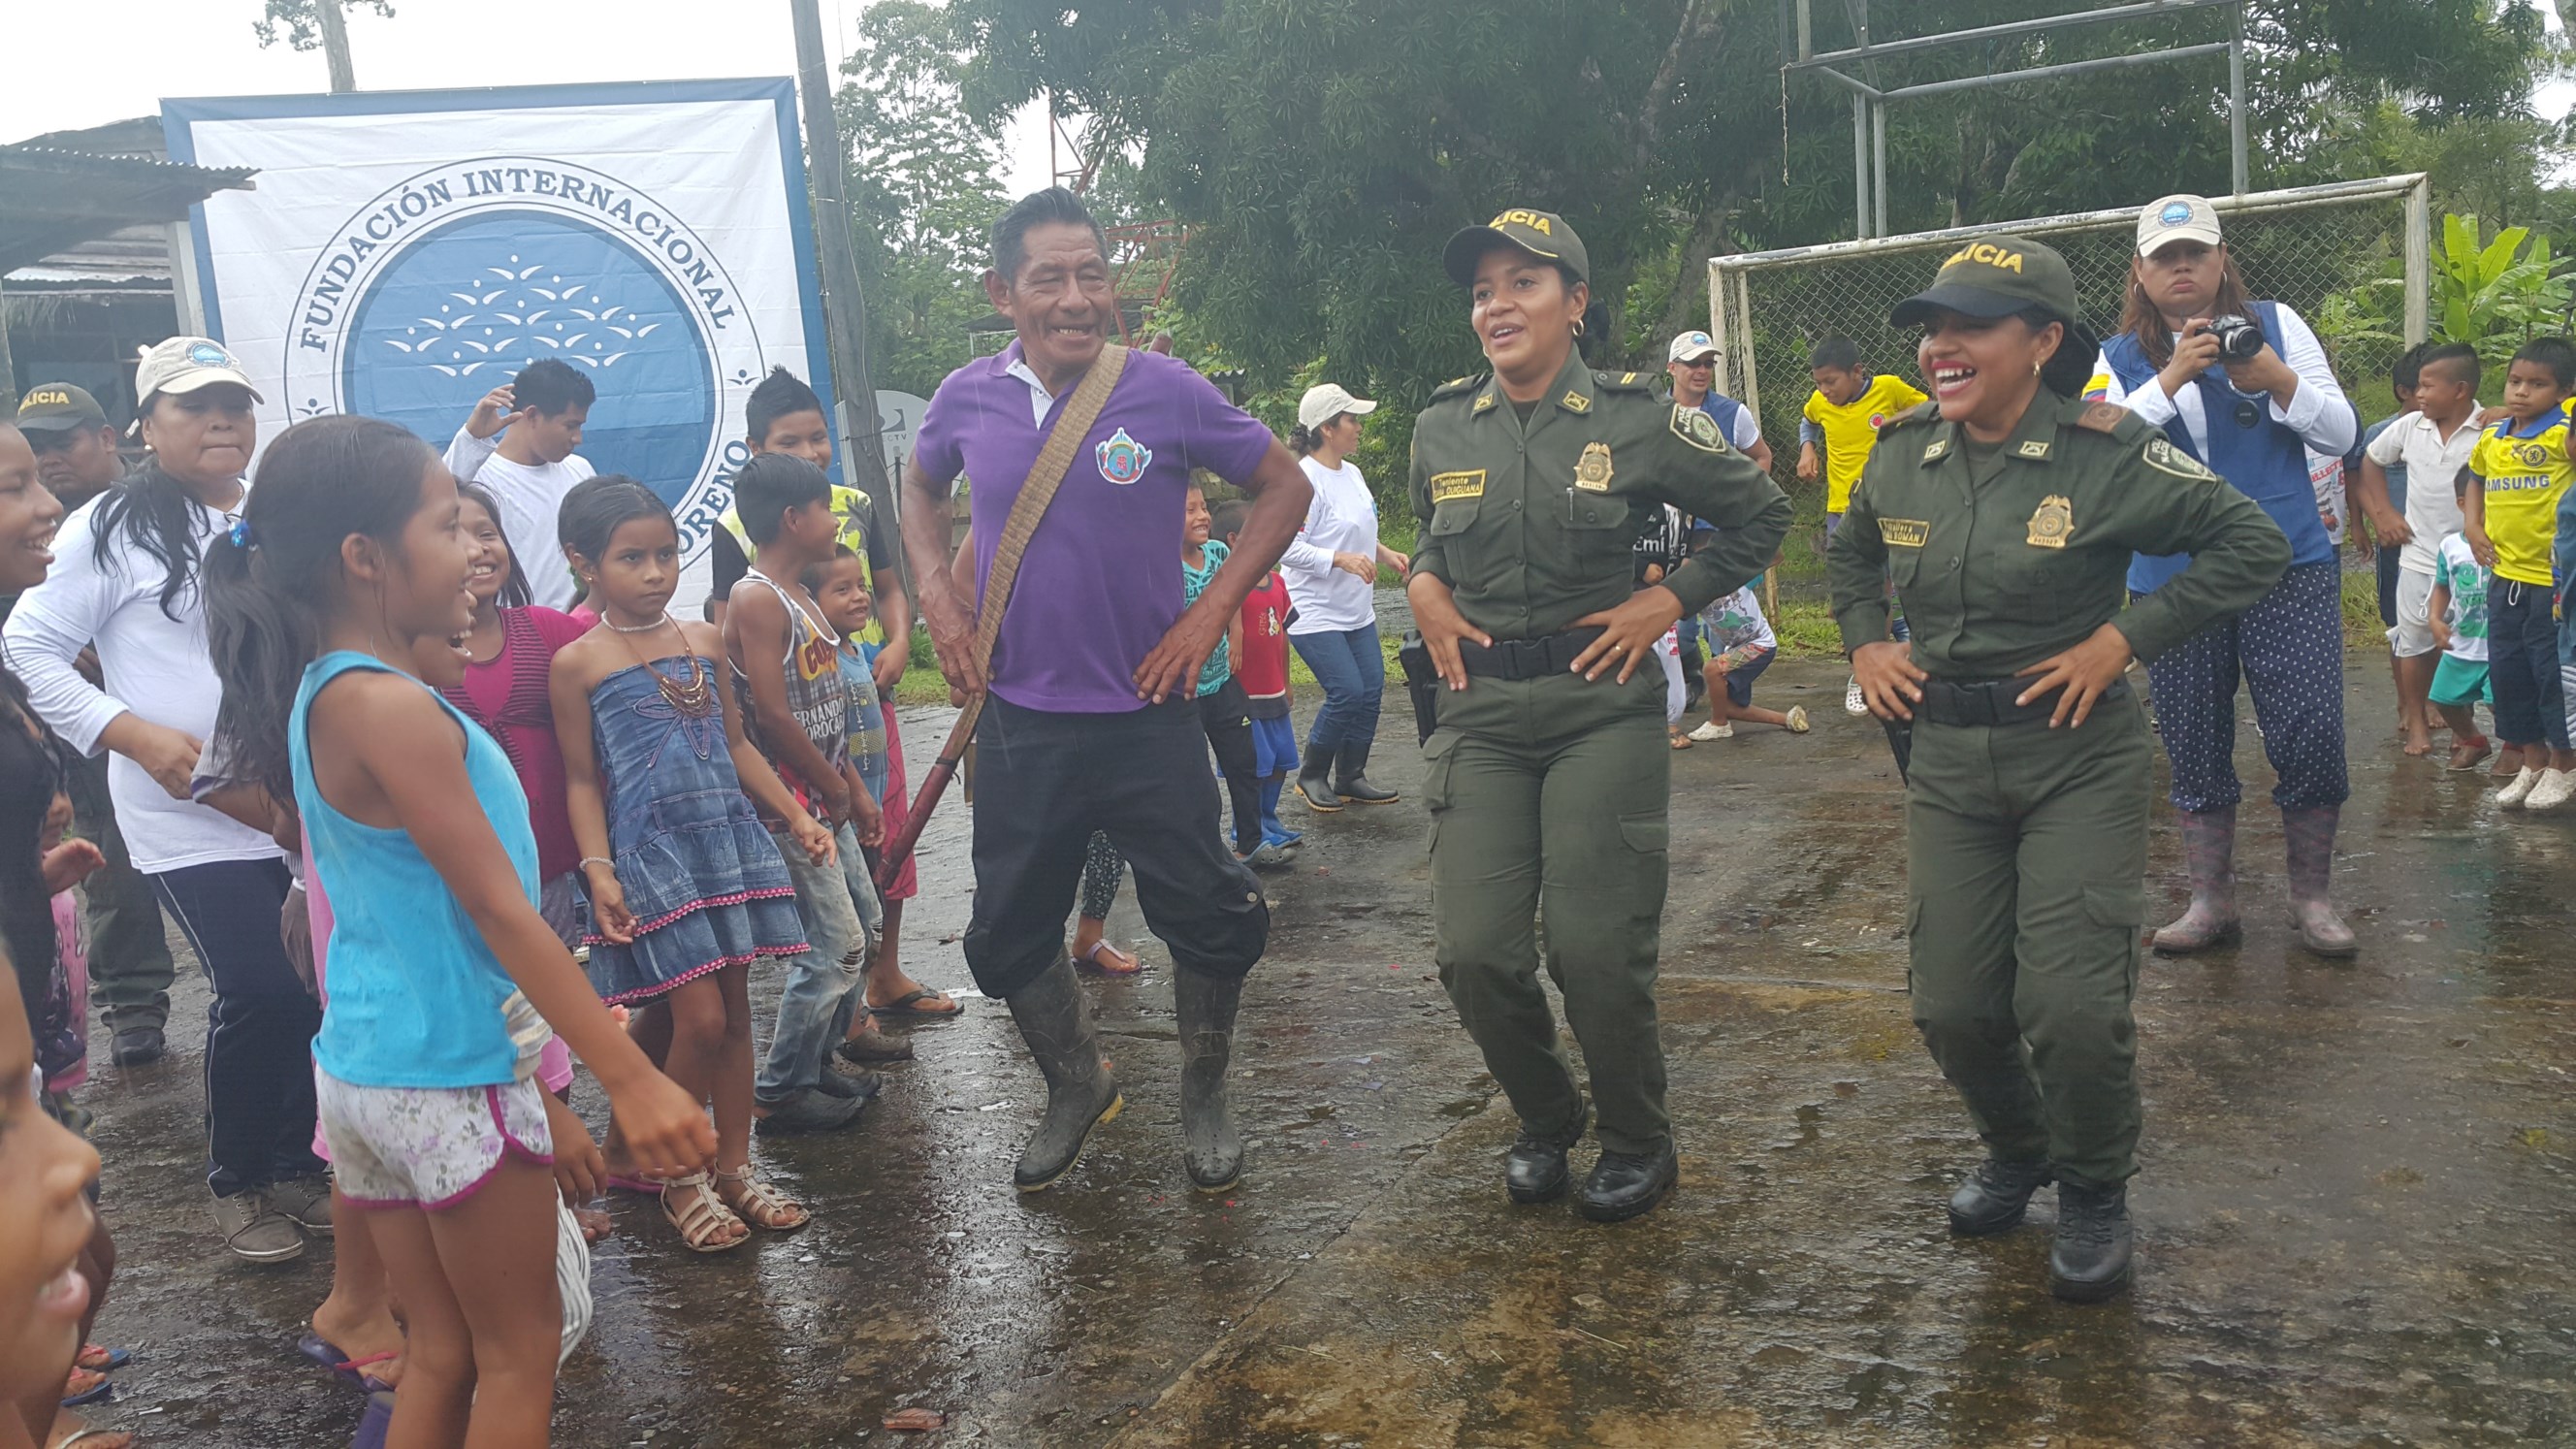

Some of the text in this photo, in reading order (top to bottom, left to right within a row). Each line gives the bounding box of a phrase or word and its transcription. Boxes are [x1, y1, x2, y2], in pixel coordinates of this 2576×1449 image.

[300, 168, 736, 353] FUNDACIÓN INTERNACIONAL
[678, 439, 751, 555] ORENO
[2485, 474, 2550, 493] AMSUNG
[792, 697, 844, 727] ERNANDO
